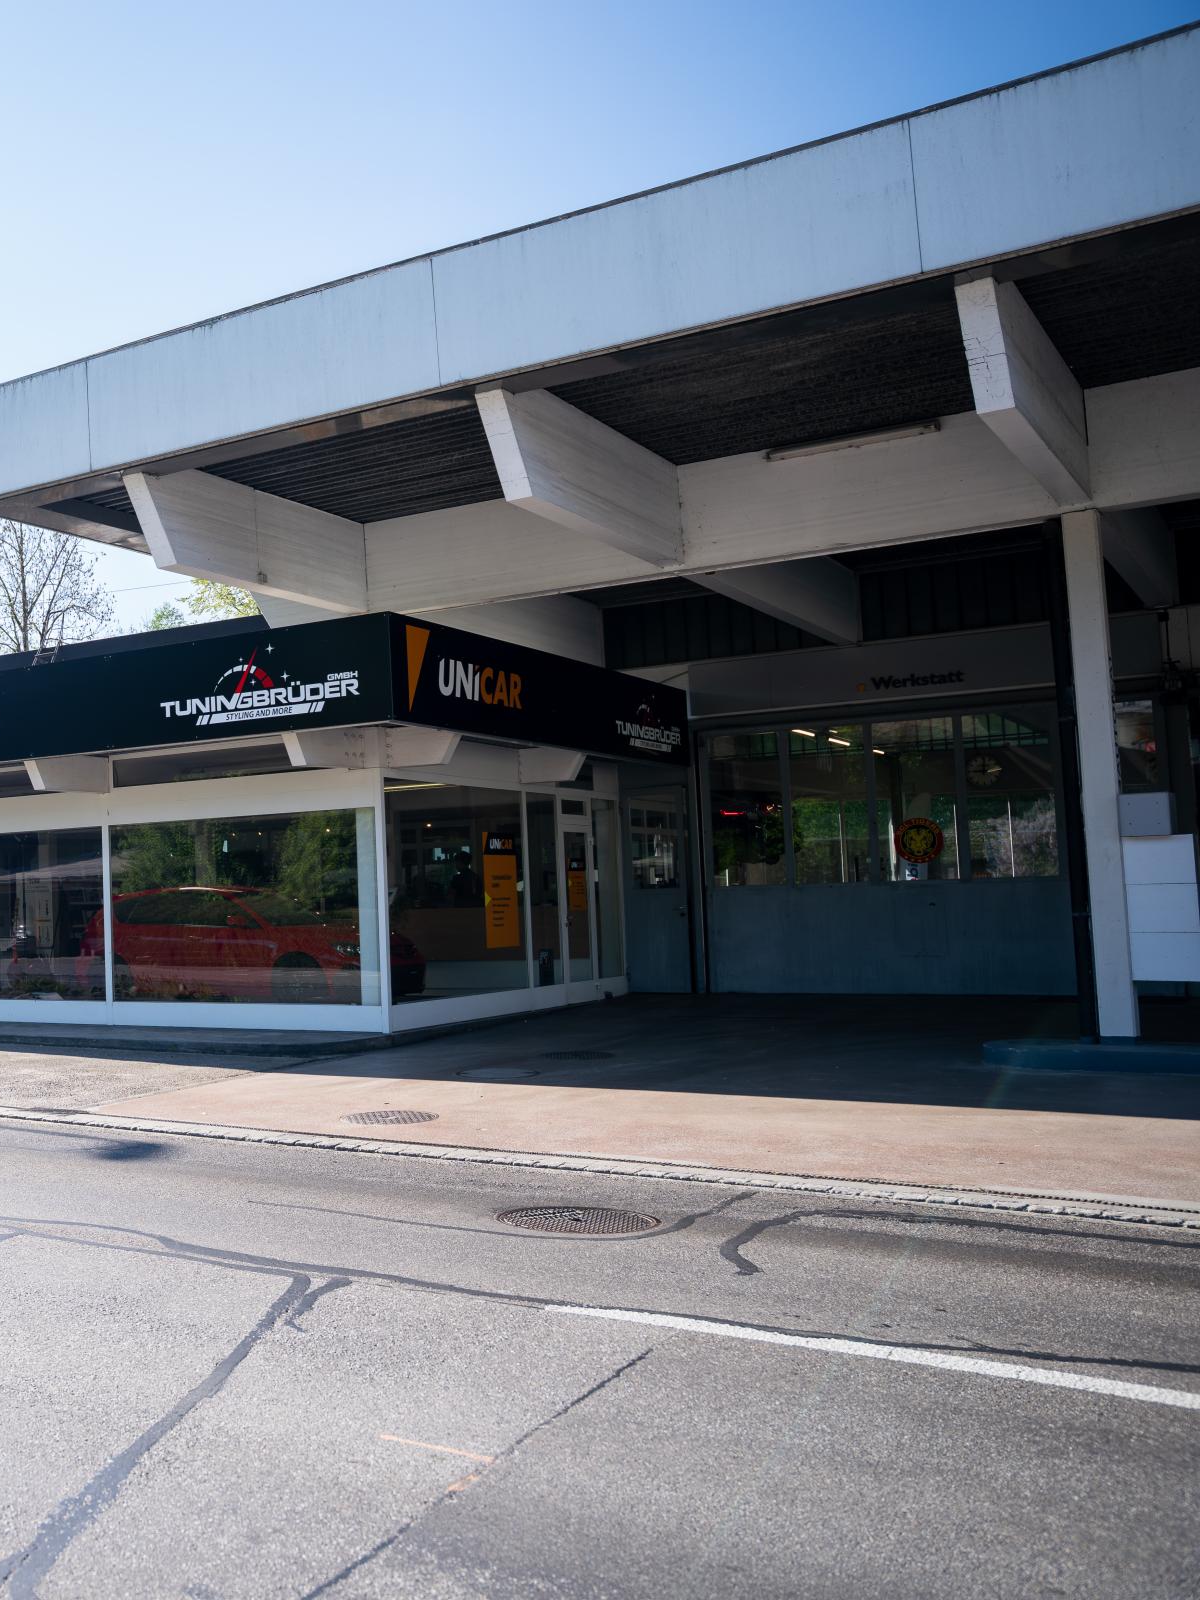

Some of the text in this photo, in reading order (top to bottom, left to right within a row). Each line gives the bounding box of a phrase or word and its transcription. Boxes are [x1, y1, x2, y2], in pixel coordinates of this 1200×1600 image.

[326, 670, 358, 681] GMBH
[871, 670, 964, 690] Werkstatt
[160, 679, 360, 718] TUNINGBRÜDER
[226, 706, 293, 721] STYLING AND MORE
